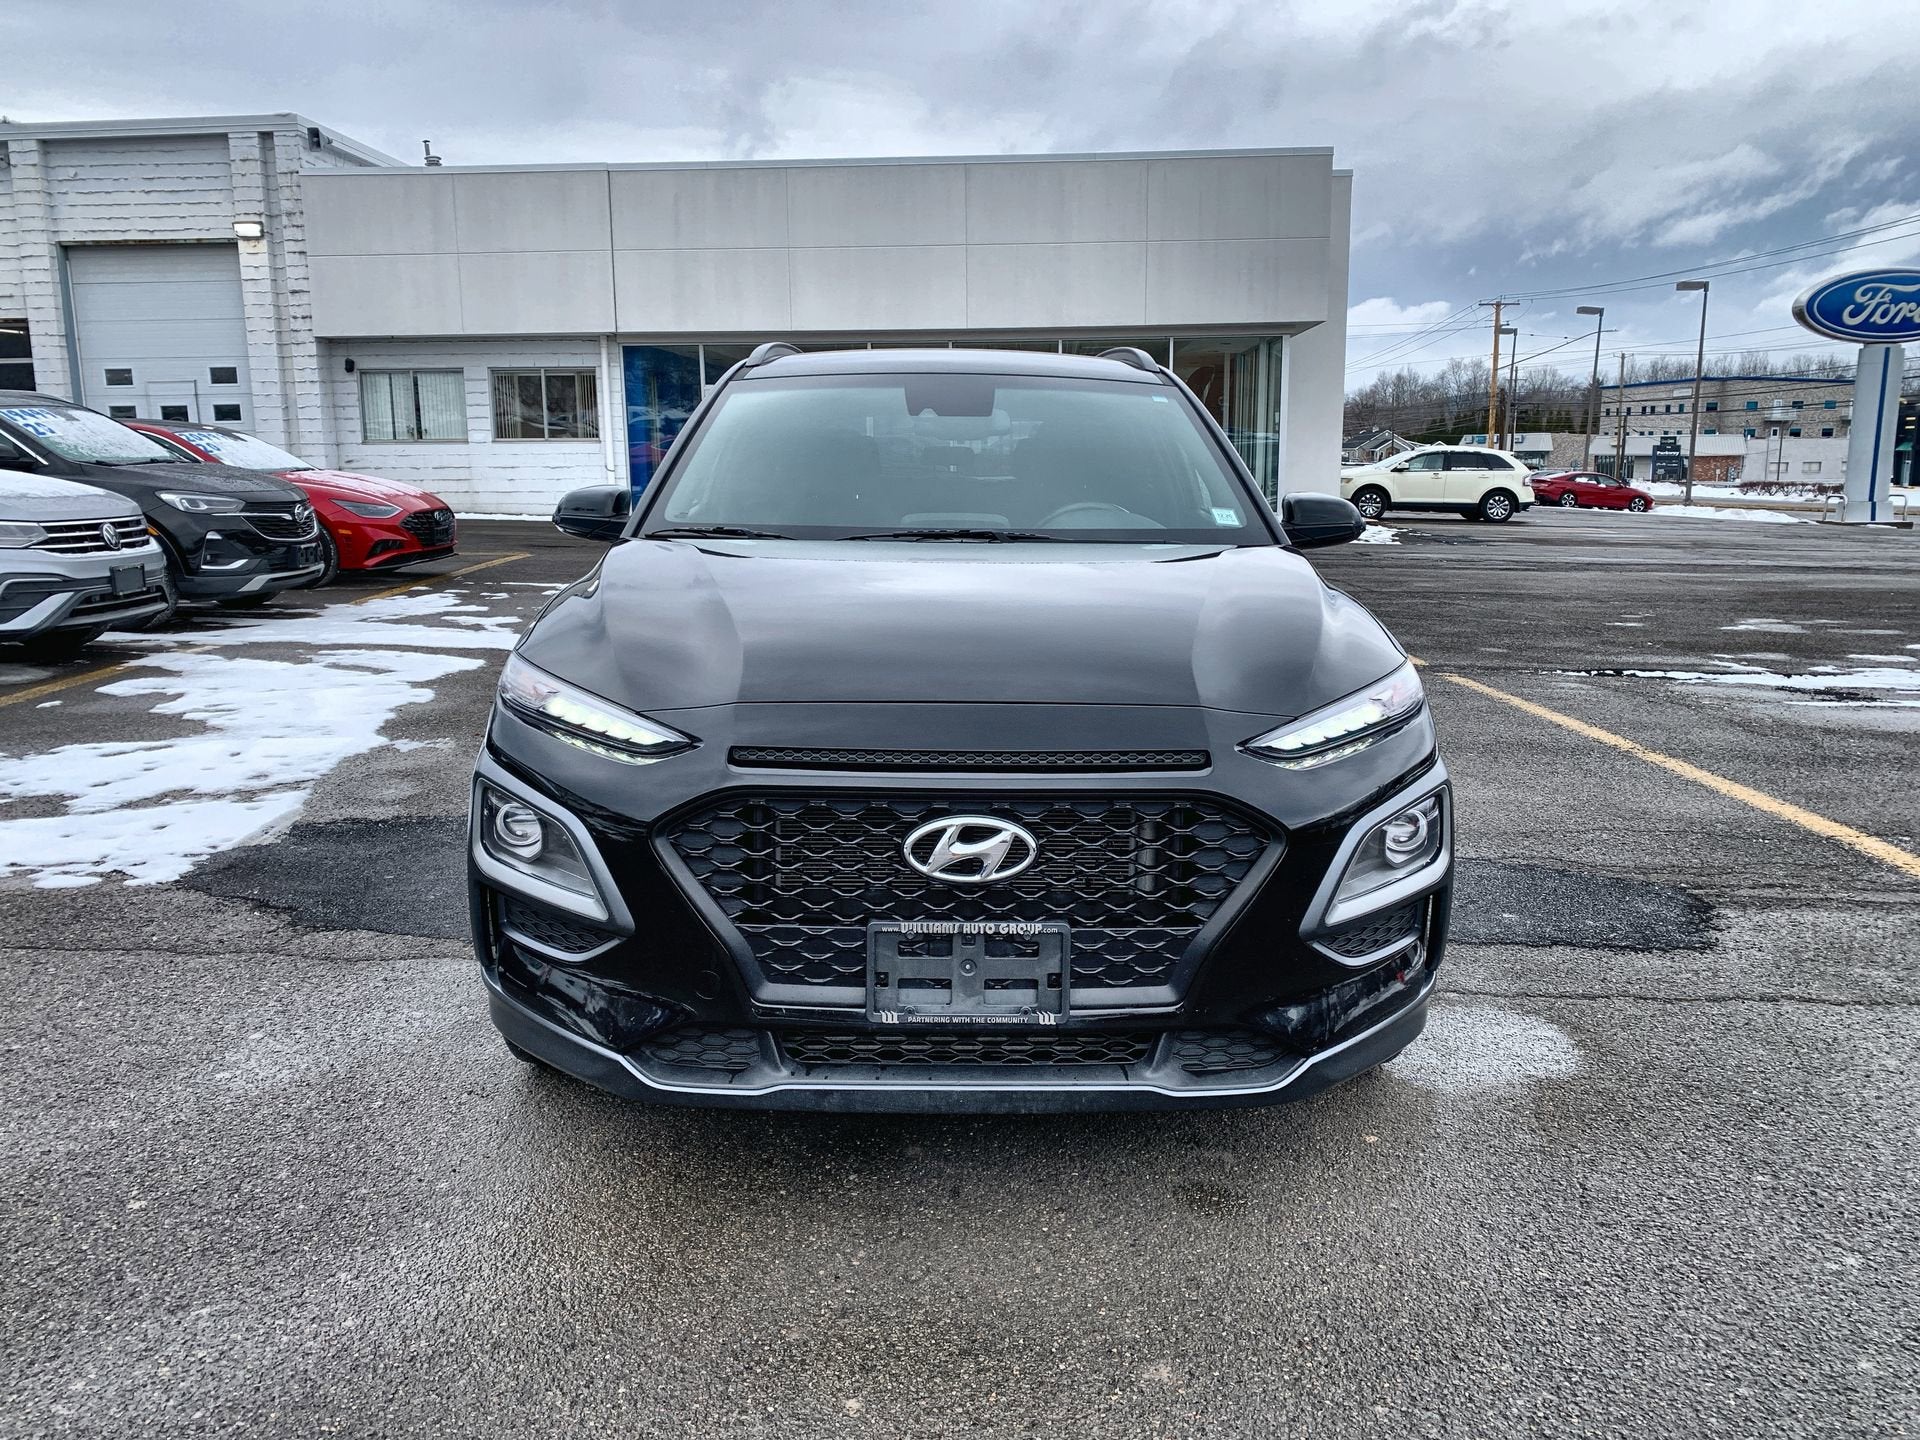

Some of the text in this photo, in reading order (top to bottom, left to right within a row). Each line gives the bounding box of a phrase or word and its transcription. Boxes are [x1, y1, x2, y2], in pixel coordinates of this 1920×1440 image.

[1842, 283, 1920, 326] For
[963, 922, 996, 934] AUTO
[907, 1016, 1029, 1024] PARTNERING WITH THE COMMUNITY
